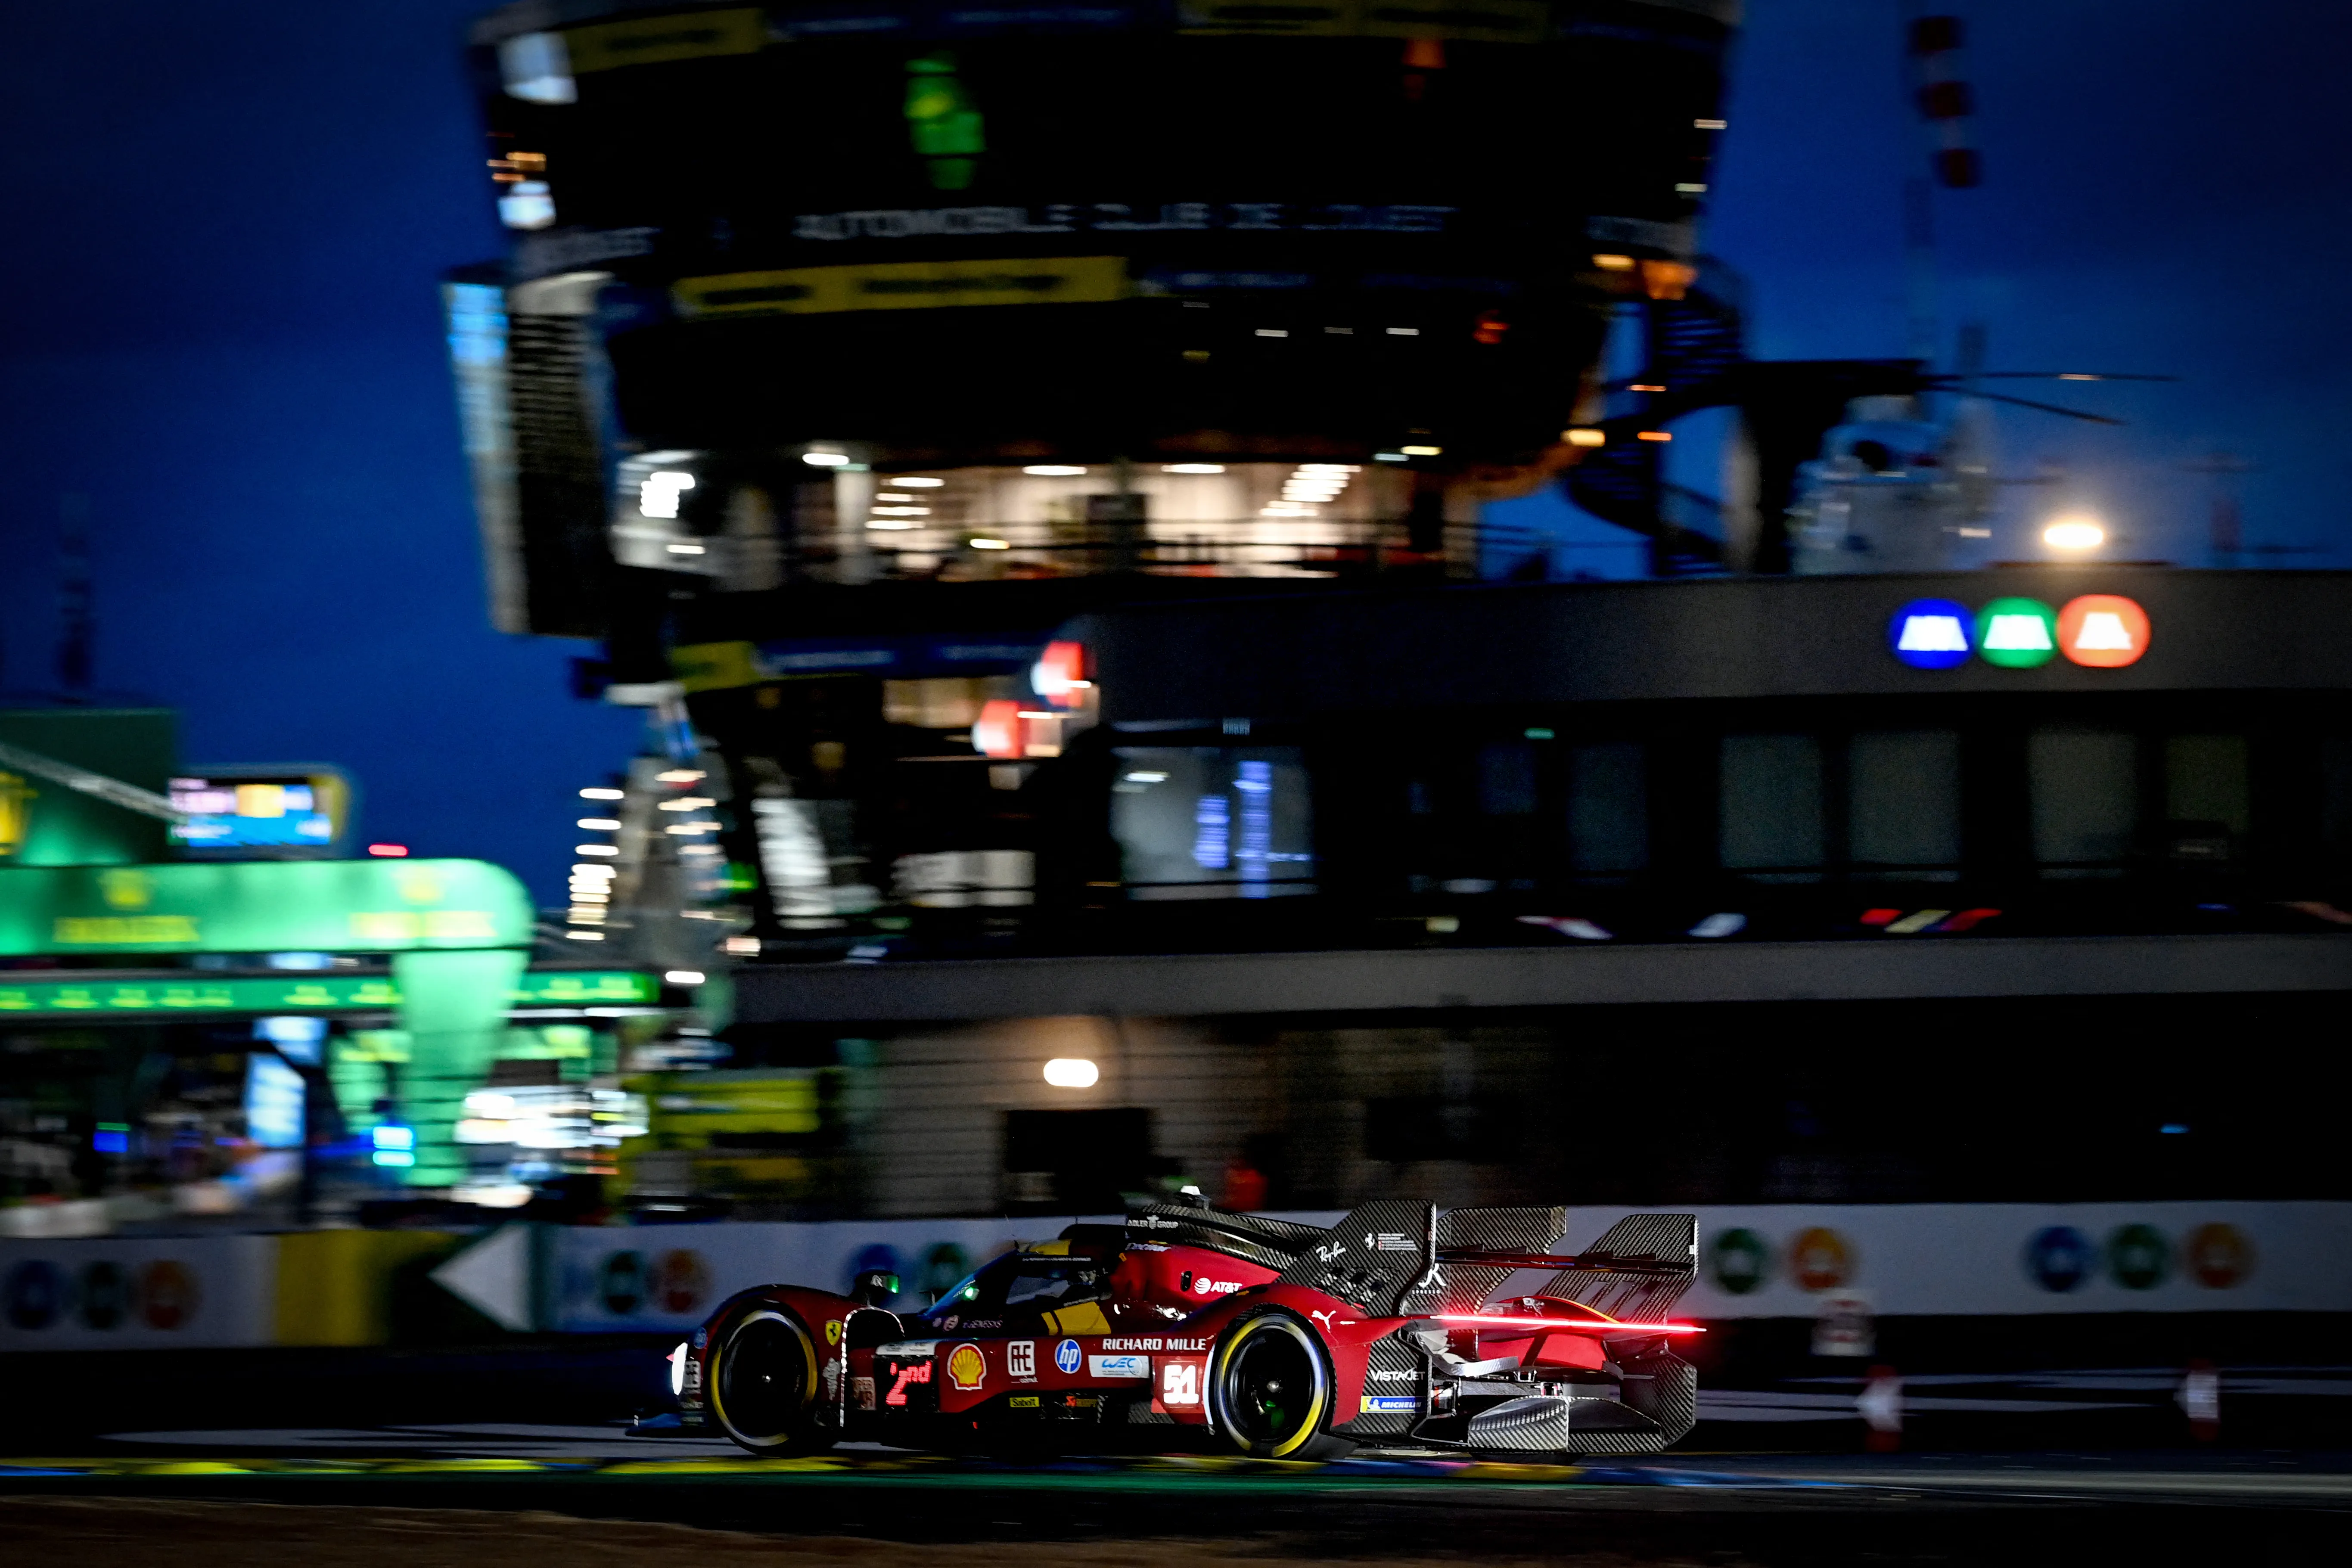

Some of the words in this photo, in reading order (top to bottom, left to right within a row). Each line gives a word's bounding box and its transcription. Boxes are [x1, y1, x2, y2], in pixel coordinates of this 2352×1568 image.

[1210, 1281, 1243, 1293] AT&T
[1103, 1338, 1162, 1350] RICHARD
[1166, 1338, 1206, 1350] MILLE
[1059, 1340, 1078, 1372] hp
[1102, 1358, 1136, 1368] WEC
[885, 1360, 932, 1406] 2nd
[1163, 1364, 1199, 1404] 51
